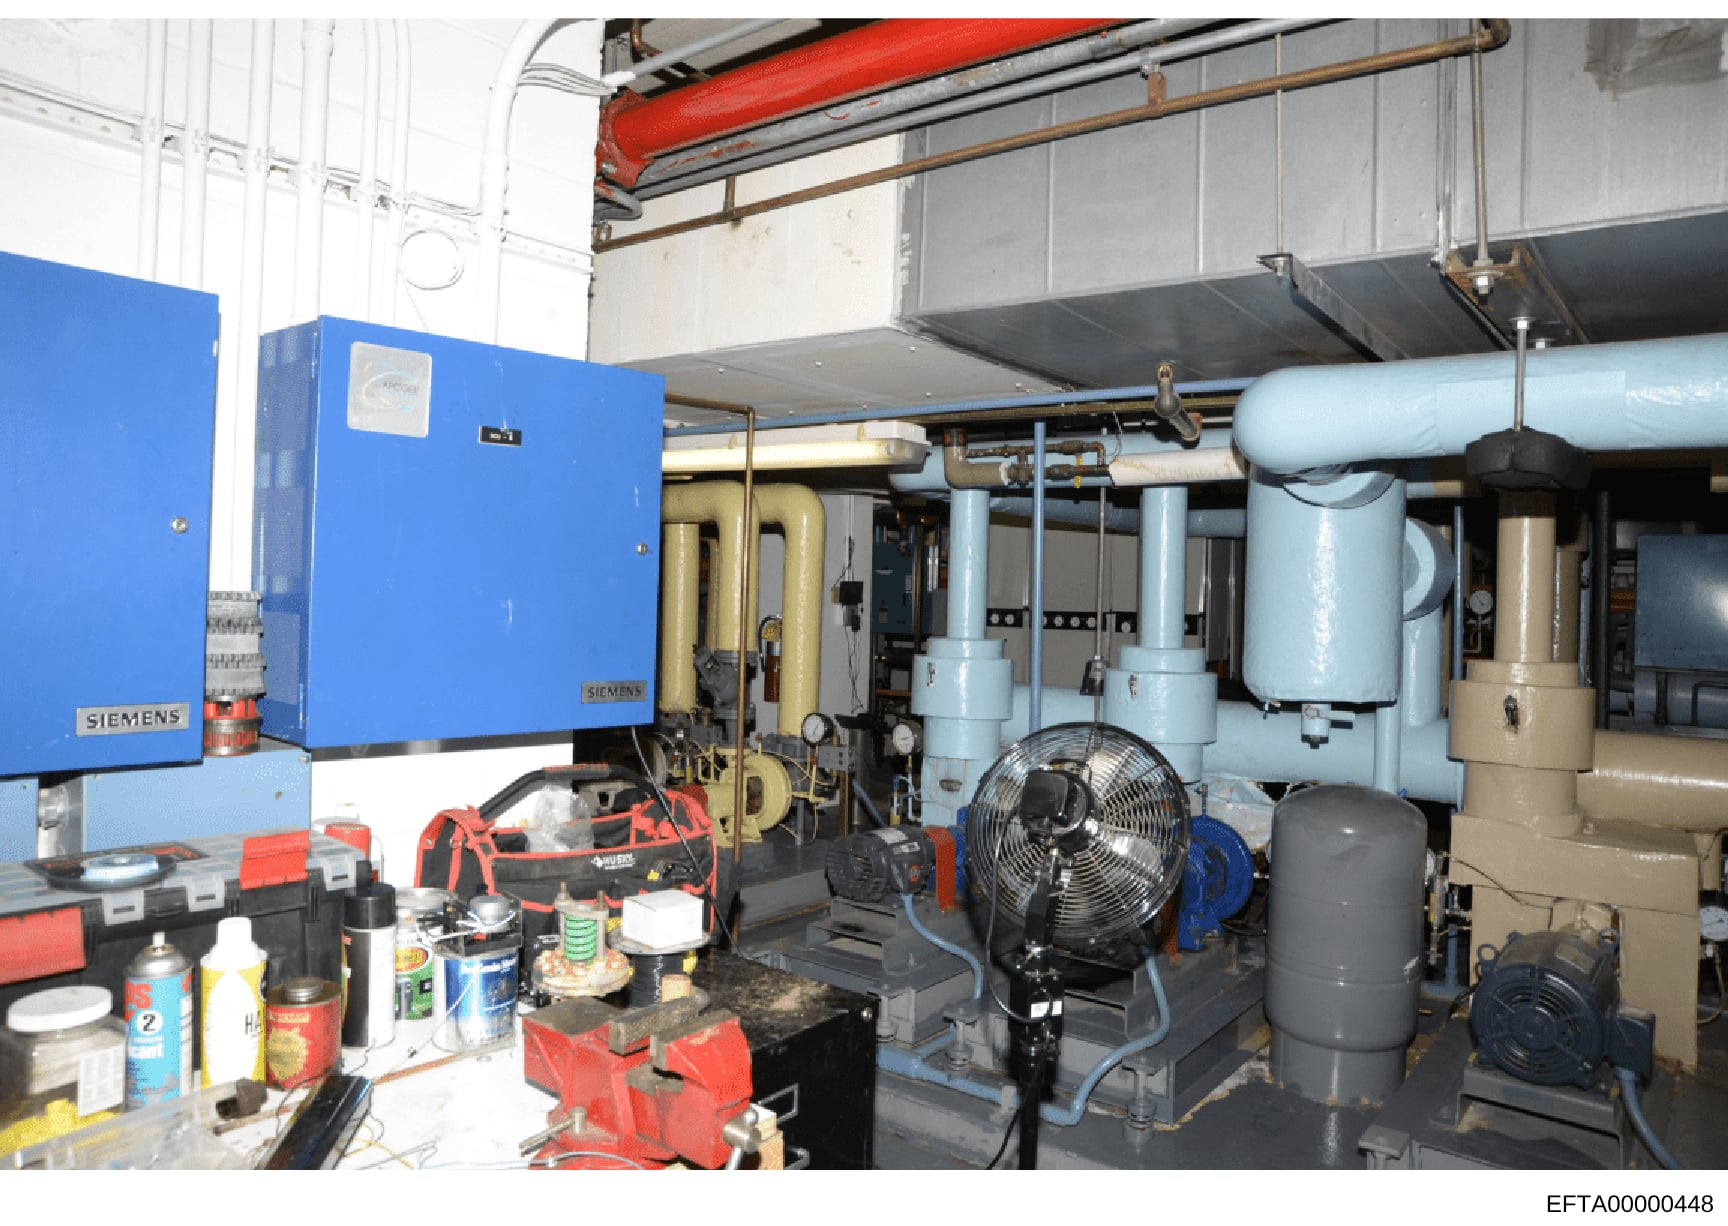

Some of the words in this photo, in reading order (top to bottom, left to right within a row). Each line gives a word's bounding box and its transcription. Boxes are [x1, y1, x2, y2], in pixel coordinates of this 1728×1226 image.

[587, 686, 642, 699] SIEMENS
[86, 710, 180, 729] SIEMENS
[142, 1013, 156, 1032] 2
